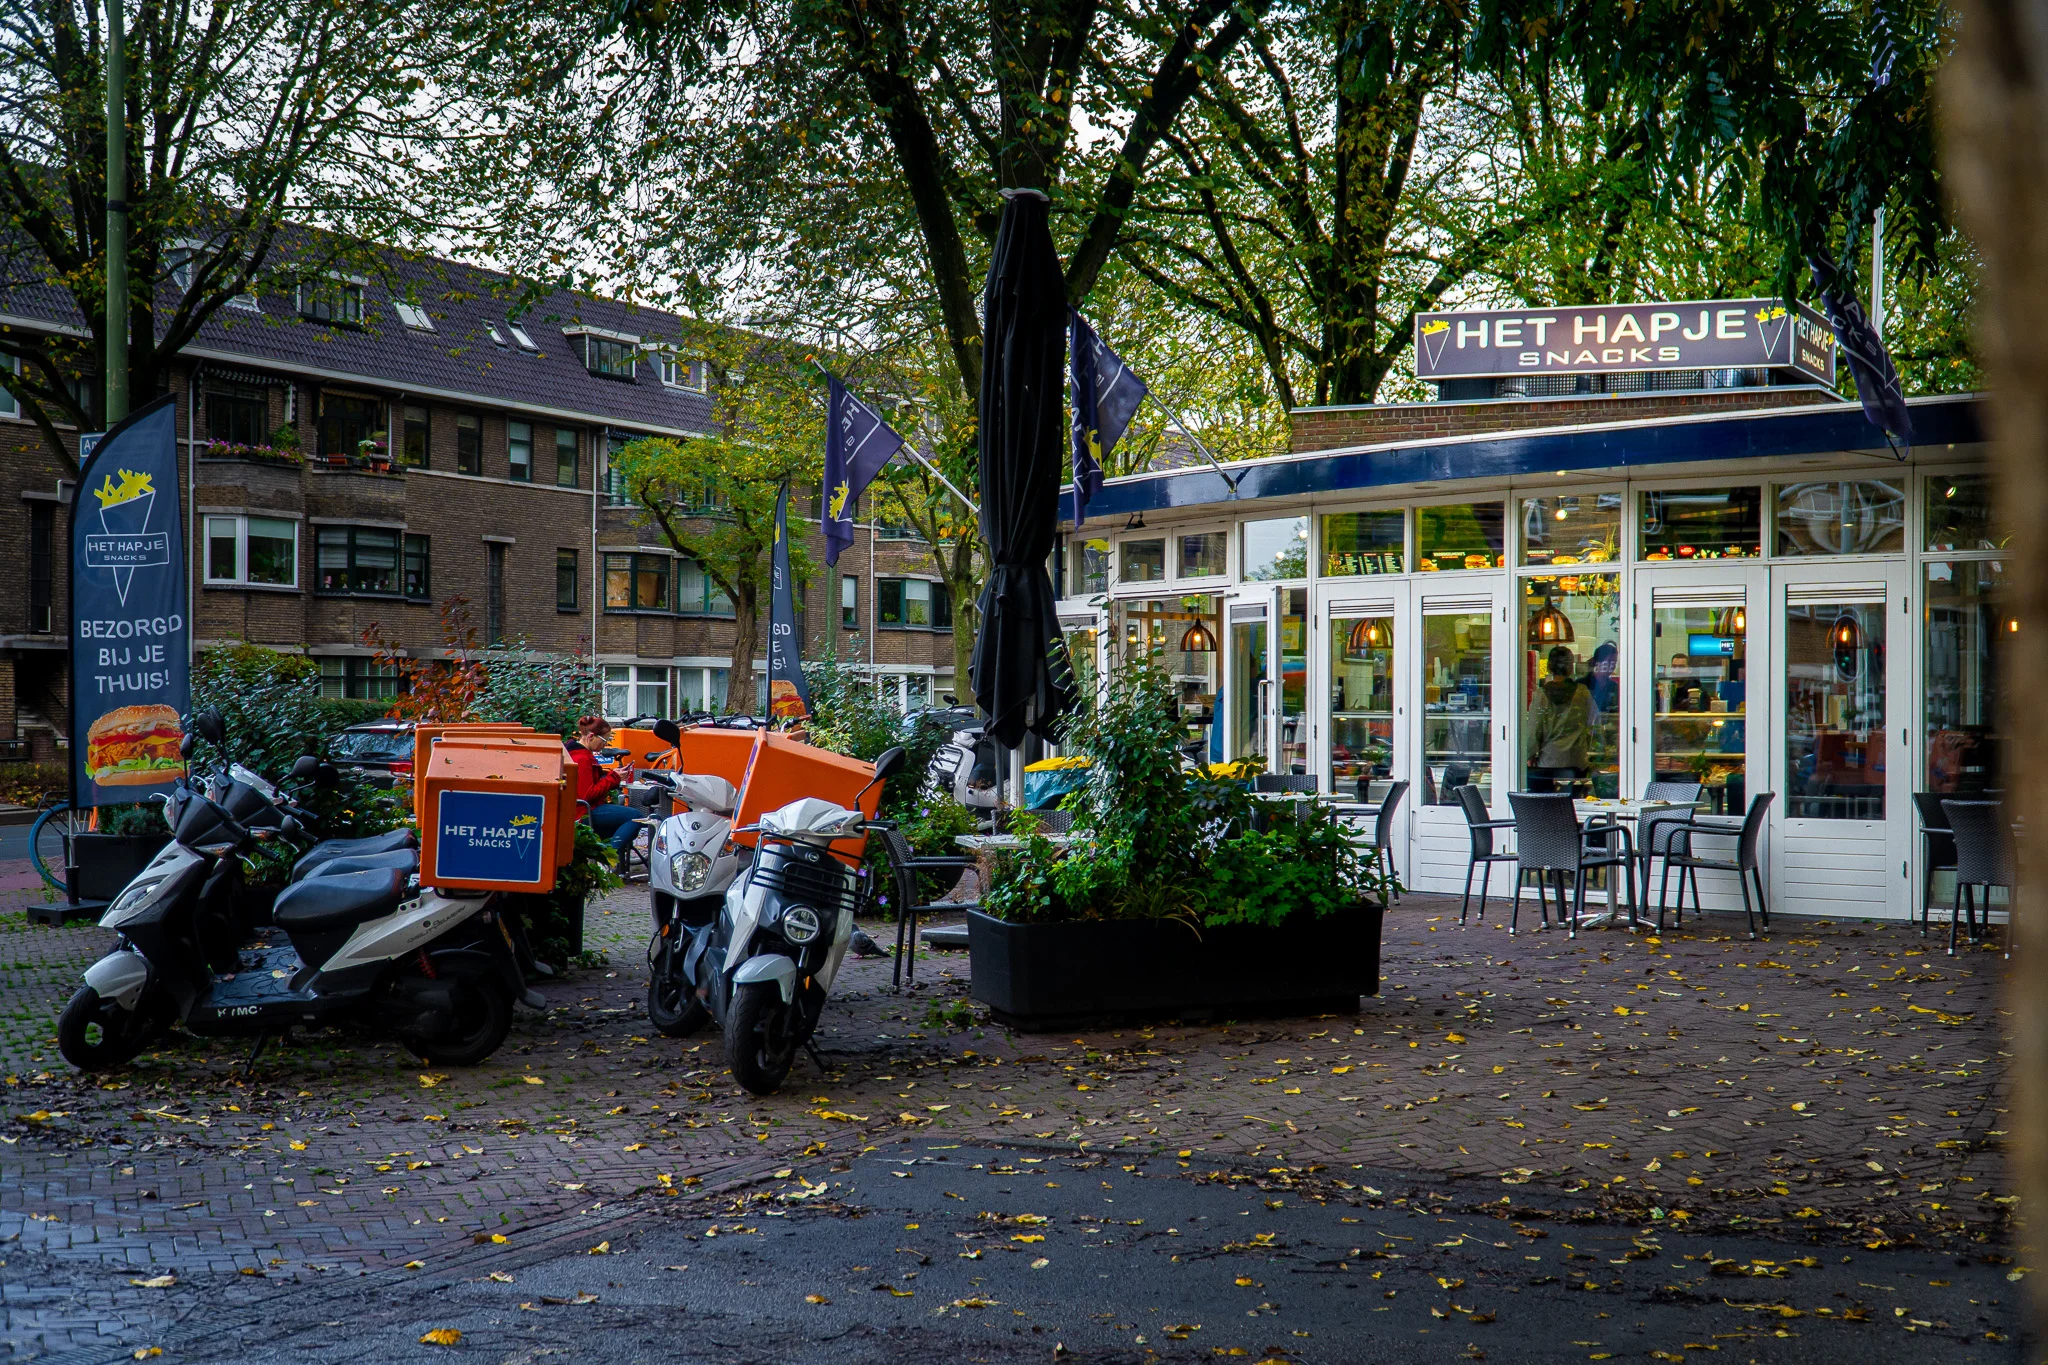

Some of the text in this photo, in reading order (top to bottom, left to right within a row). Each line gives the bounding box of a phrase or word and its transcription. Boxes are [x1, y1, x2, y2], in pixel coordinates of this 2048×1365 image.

[1457, 309, 1747, 349] HET HAPJE
[1798, 315, 1829, 353] HET HAPJE
[1518, 346, 1681, 366] SNACKS
[1802, 348, 1825, 372] SNACKS
[88, 539, 165, 552] HET HAPJE
[80, 614, 183, 639] BEZORGD
[98, 645, 165, 666] BIJ JE
[94, 669, 170, 694] THUIS!
[445, 825, 536, 840] HET HAPJE
[468, 838, 512, 848] SNACKS
